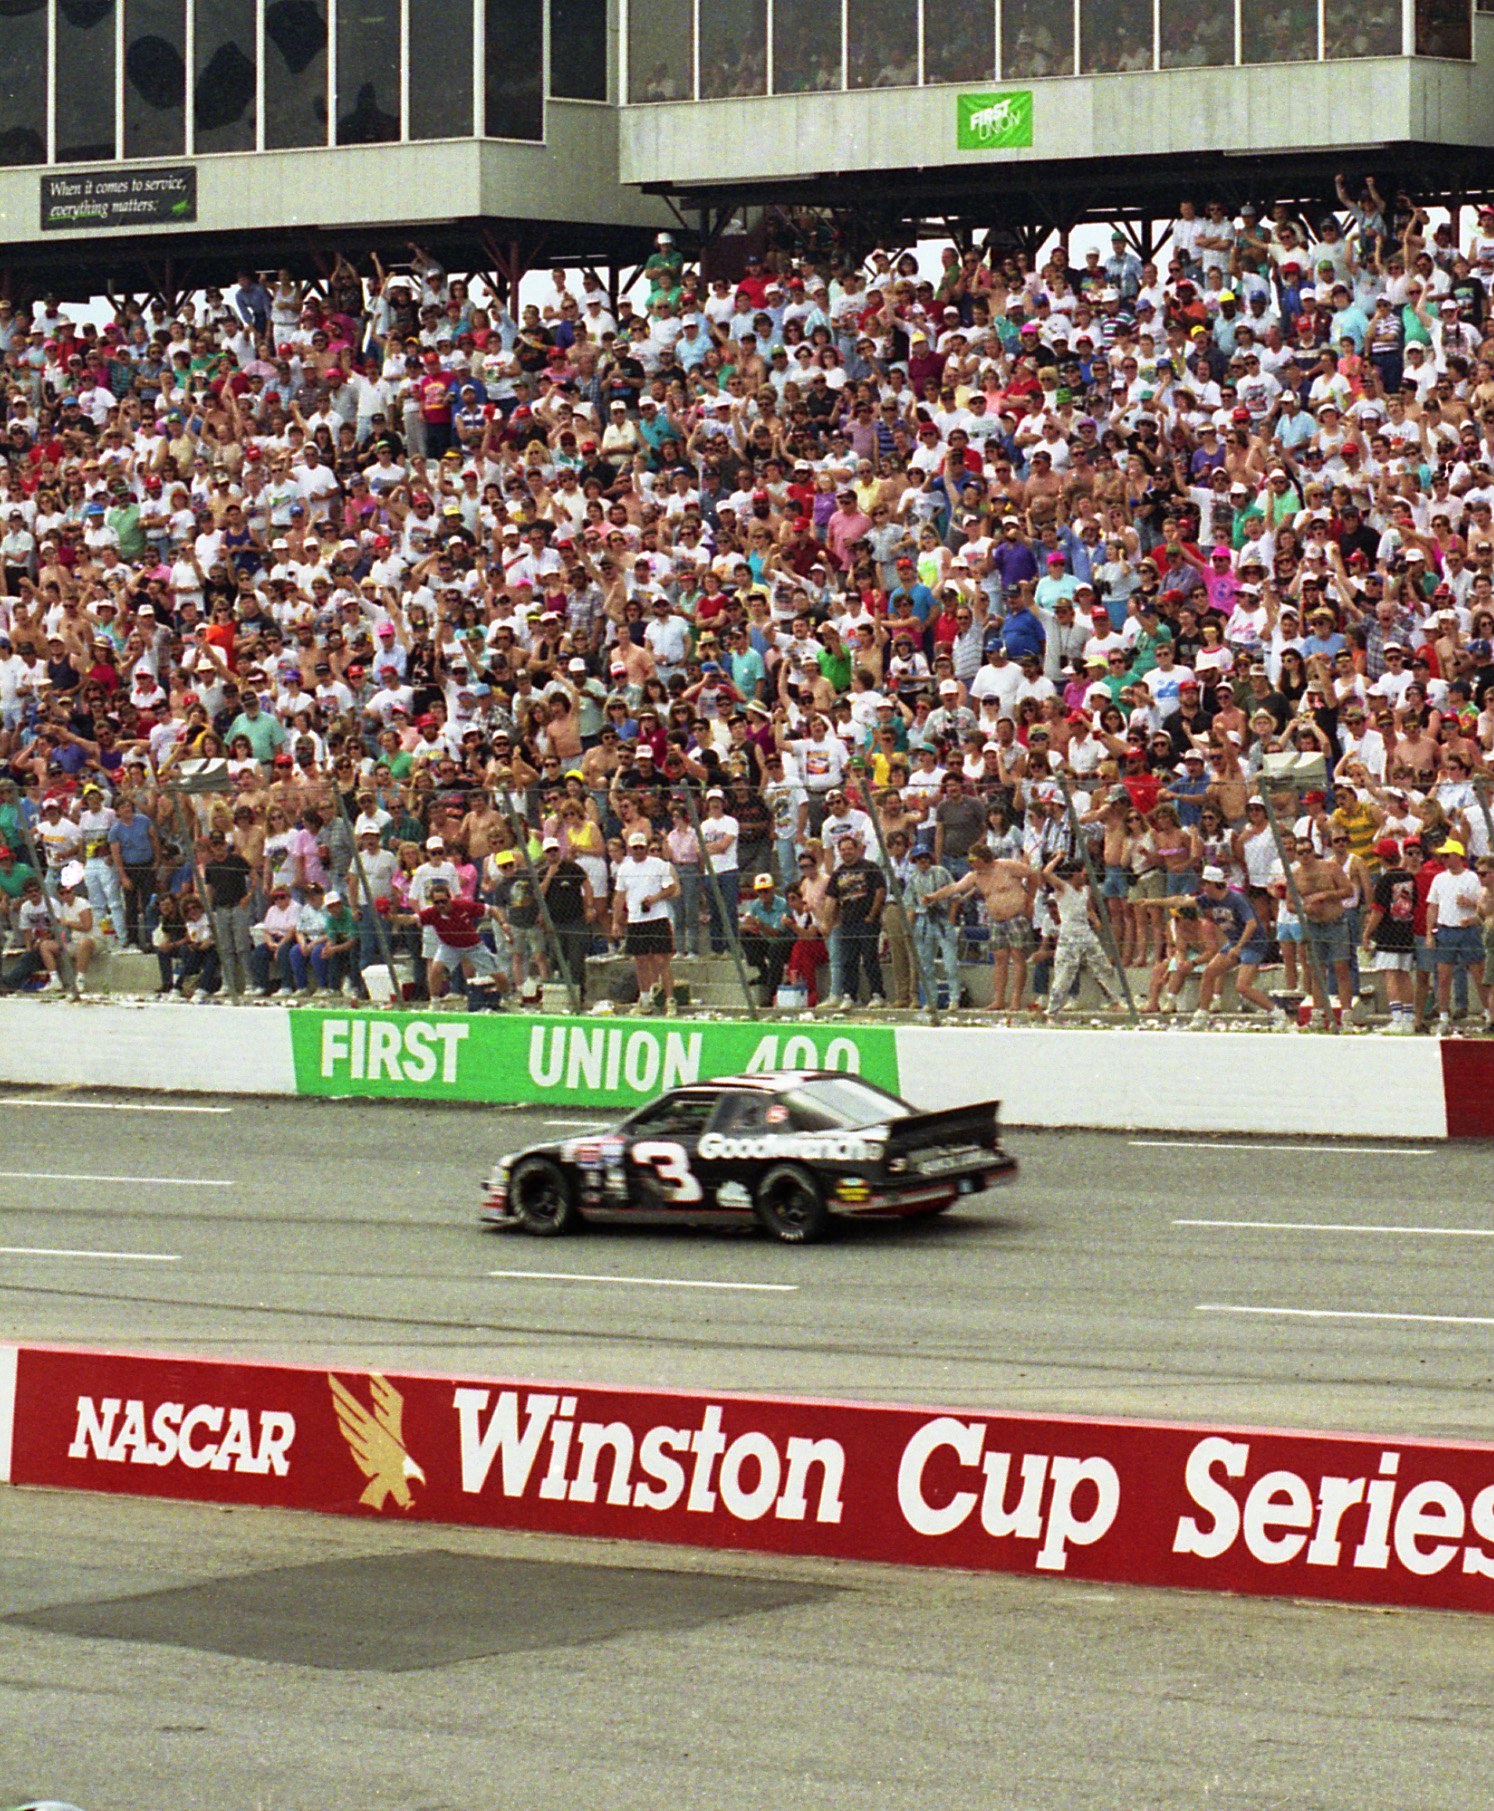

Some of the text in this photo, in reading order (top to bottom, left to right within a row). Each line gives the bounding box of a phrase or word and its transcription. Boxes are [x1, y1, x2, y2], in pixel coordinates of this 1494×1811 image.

[970, 98, 1012, 131] FIRST
[979, 110, 1021, 141] UNION
[50, 175, 187, 196] When it comes to service,
[50, 199, 109, 219] everything
[321, 1019, 469, 1083] FIRST
[527, 1025, 703, 1092] UNION
[745, 1034, 861, 1075] 400
[632, 1140, 704, 1203] 3
[67, 1395, 297, 1477] NASCAR
[451, 1386, 848, 1524] Winston
[896, 1416, 1121, 1571] Cup
